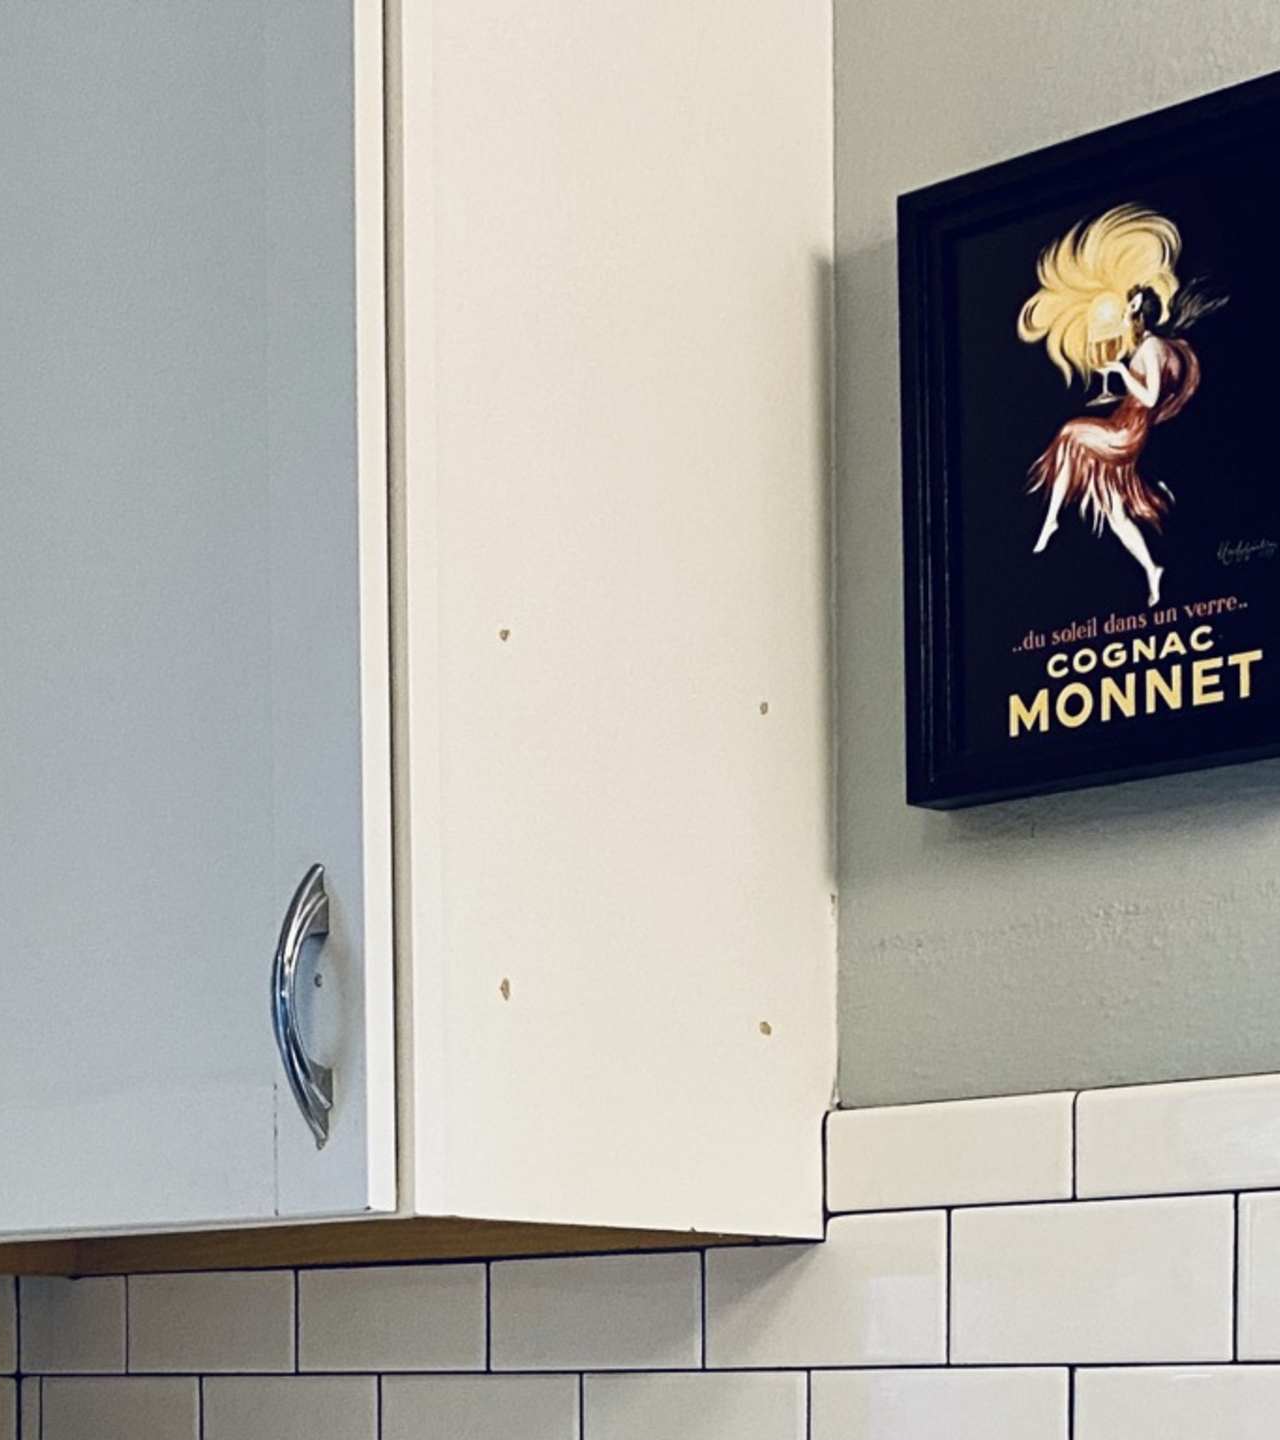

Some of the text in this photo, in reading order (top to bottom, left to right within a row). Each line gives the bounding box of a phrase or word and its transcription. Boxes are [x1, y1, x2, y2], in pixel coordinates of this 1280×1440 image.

[1047, 625, 1214, 678] COGNAC
[1051, 617, 1097, 646] soleil
[1104, 612, 1147, 635] dans
[1154, 607, 1177, 625] un
[1009, 649, 1263, 737] MONNET
